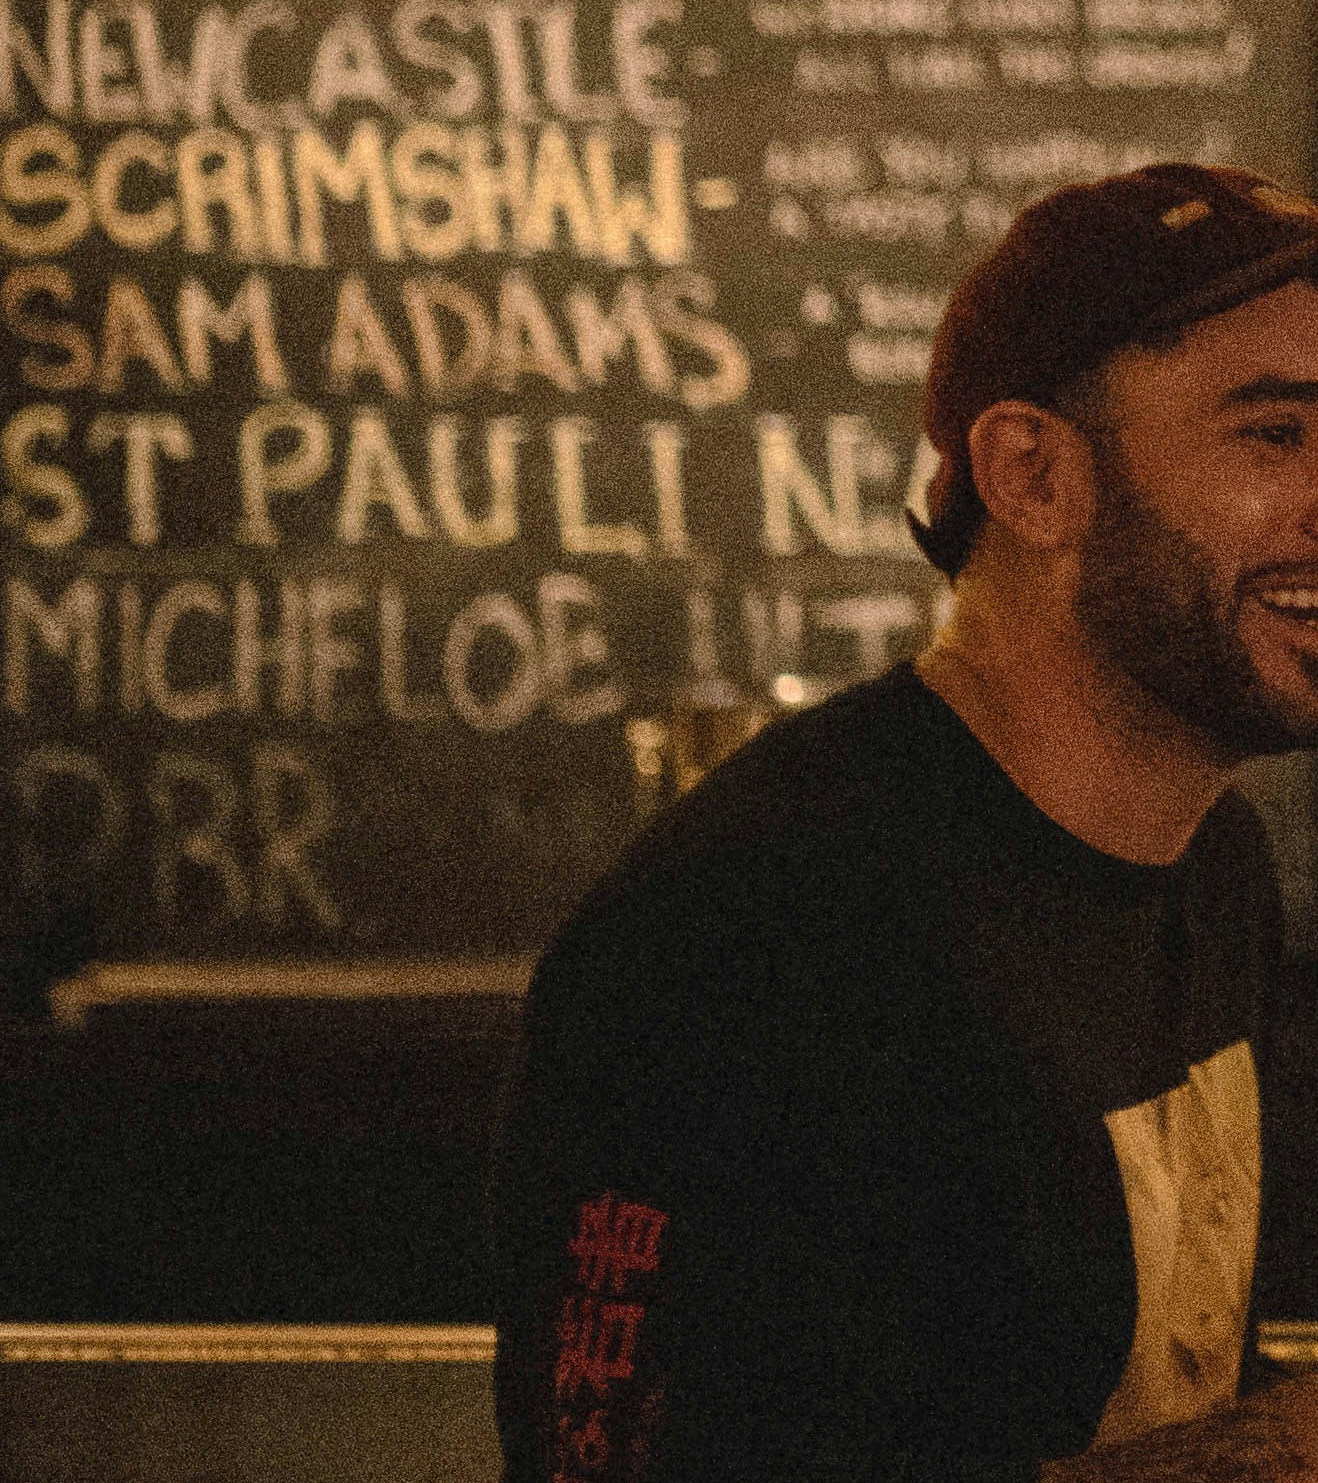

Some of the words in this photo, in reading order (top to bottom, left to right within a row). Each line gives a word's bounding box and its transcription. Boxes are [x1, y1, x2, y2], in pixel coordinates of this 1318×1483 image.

[4, 264, 290, 396] SAM
[326, 268, 752, 412] ADAMS
[3, 402, 192, 549] ST
[236, 395, 690, 559] PAULI
